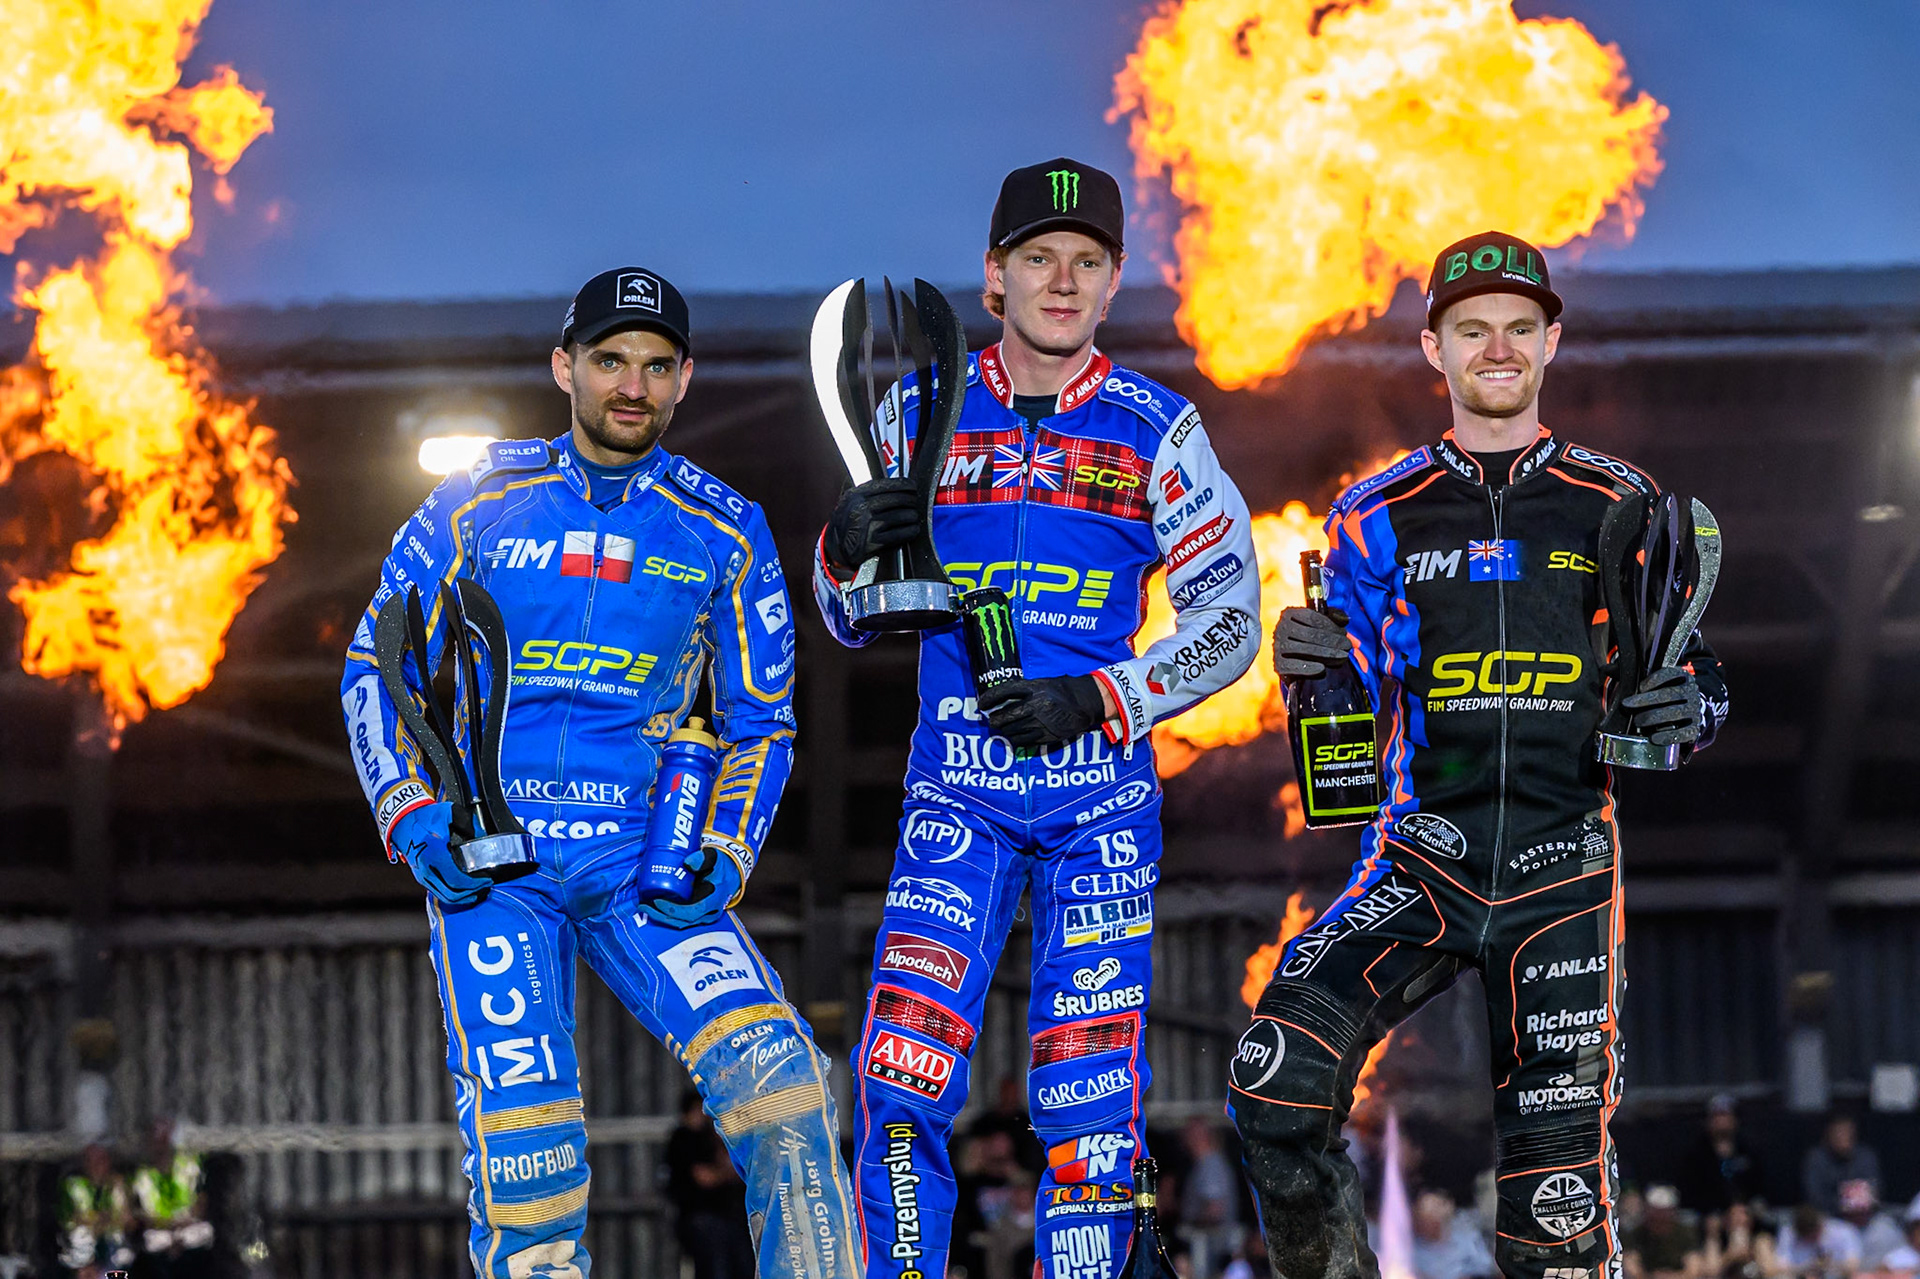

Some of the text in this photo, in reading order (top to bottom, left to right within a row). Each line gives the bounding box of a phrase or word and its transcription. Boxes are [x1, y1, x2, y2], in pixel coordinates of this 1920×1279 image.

[1444, 245, 1541, 283] BOLL
[623, 295, 655, 306] ORLEN
[987, 370, 1006, 397] ANLAS
[1075, 372, 1103, 400] ANLAS
[498, 445, 541, 457] ORLEN
[1443, 449, 1473, 478] ANLAS
[940, 454, 988, 486] IM
[1073, 465, 1140, 490] SGP
[1342, 453, 1424, 510] GARCAREK
[1627, 475, 1648, 493] bizne
[1155, 487, 1213, 536] BETARD
[403, 546, 414, 561] OIL
[408, 536, 434, 569] ORLEN
[485, 538, 557, 569] FIM
[1703, 544, 1718, 553] 3rd
[642, 556, 708, 584] SGP
[1404, 550, 1462, 584] FIM
[1177, 559, 1238, 604] Wrocław
[1022, 609, 1098, 630] GRAND PRIX
[514, 640, 633, 675] SGP
[525, 675, 582, 690] SPEEDWAY
[582, 681, 615, 694] GRAND
[618, 686, 639, 698] PRIX
[1428, 650, 1583, 698] SGP
[1428, 697, 1574, 712] FIM SPEEDWAY GRAND PRIX
[642, 713, 670, 738] 95
[356, 722, 382, 789] ORLEN
[942, 730, 1113, 772] BIO OIL
[1315, 742, 1367, 762] SGP
[940, 764, 1116, 796] wkłady-biooil
[1323, 762, 1350, 770] SPEEDWAY
[1315, 774, 1376, 788] MANCHESTER
[671, 772, 700, 849] verva
[1075, 785, 1141, 825] BATEX
[911, 820, 961, 846] ATPI
[1417, 829, 1457, 856] Hughes
[1509, 842, 1577, 869] EASTERN
[1522, 853, 1568, 873] POINT
[1071, 862, 1156, 896] CLINIC
[1066, 894, 1149, 929] ALBON
[1066, 924, 1104, 936] ENGINEERING
[1112, 914, 1151, 928] MANUFACTURING
[523, 944, 542, 1004] Logistics
[694, 969, 749, 992] ORLEN
[884, 951, 952, 982] Alpodach
[1545, 955, 1608, 979] ANLAS
[1053, 984, 1144, 1017] ŚRUBRES
[1526, 1002, 1608, 1034] Richard
[731, 1024, 774, 1048] ORLEN
[1536, 1030, 1602, 1053] Hayes
[740, 1035, 800, 1079] Team
[873, 1037, 950, 1081] AMD
[1238, 1041, 1272, 1067] ATPI
[872, 1064, 938, 1093] GROUP
[1038, 1067, 1132, 1106] GARCAREK
[1518, 1084, 1600, 1107] MOTOREX
[1520, 1098, 1602, 1115] Oil of Switzerland
[489, 1143, 577, 1183] PROFBUD
[805, 1159, 822, 1197] Jörg
[1045, 1183, 1133, 1206] TOLS
[778, 1183, 797, 1242] Insurance
[1534, 1203, 1569, 1215] CHALLENGE
[1052, 1224, 1111, 1268] MOON
